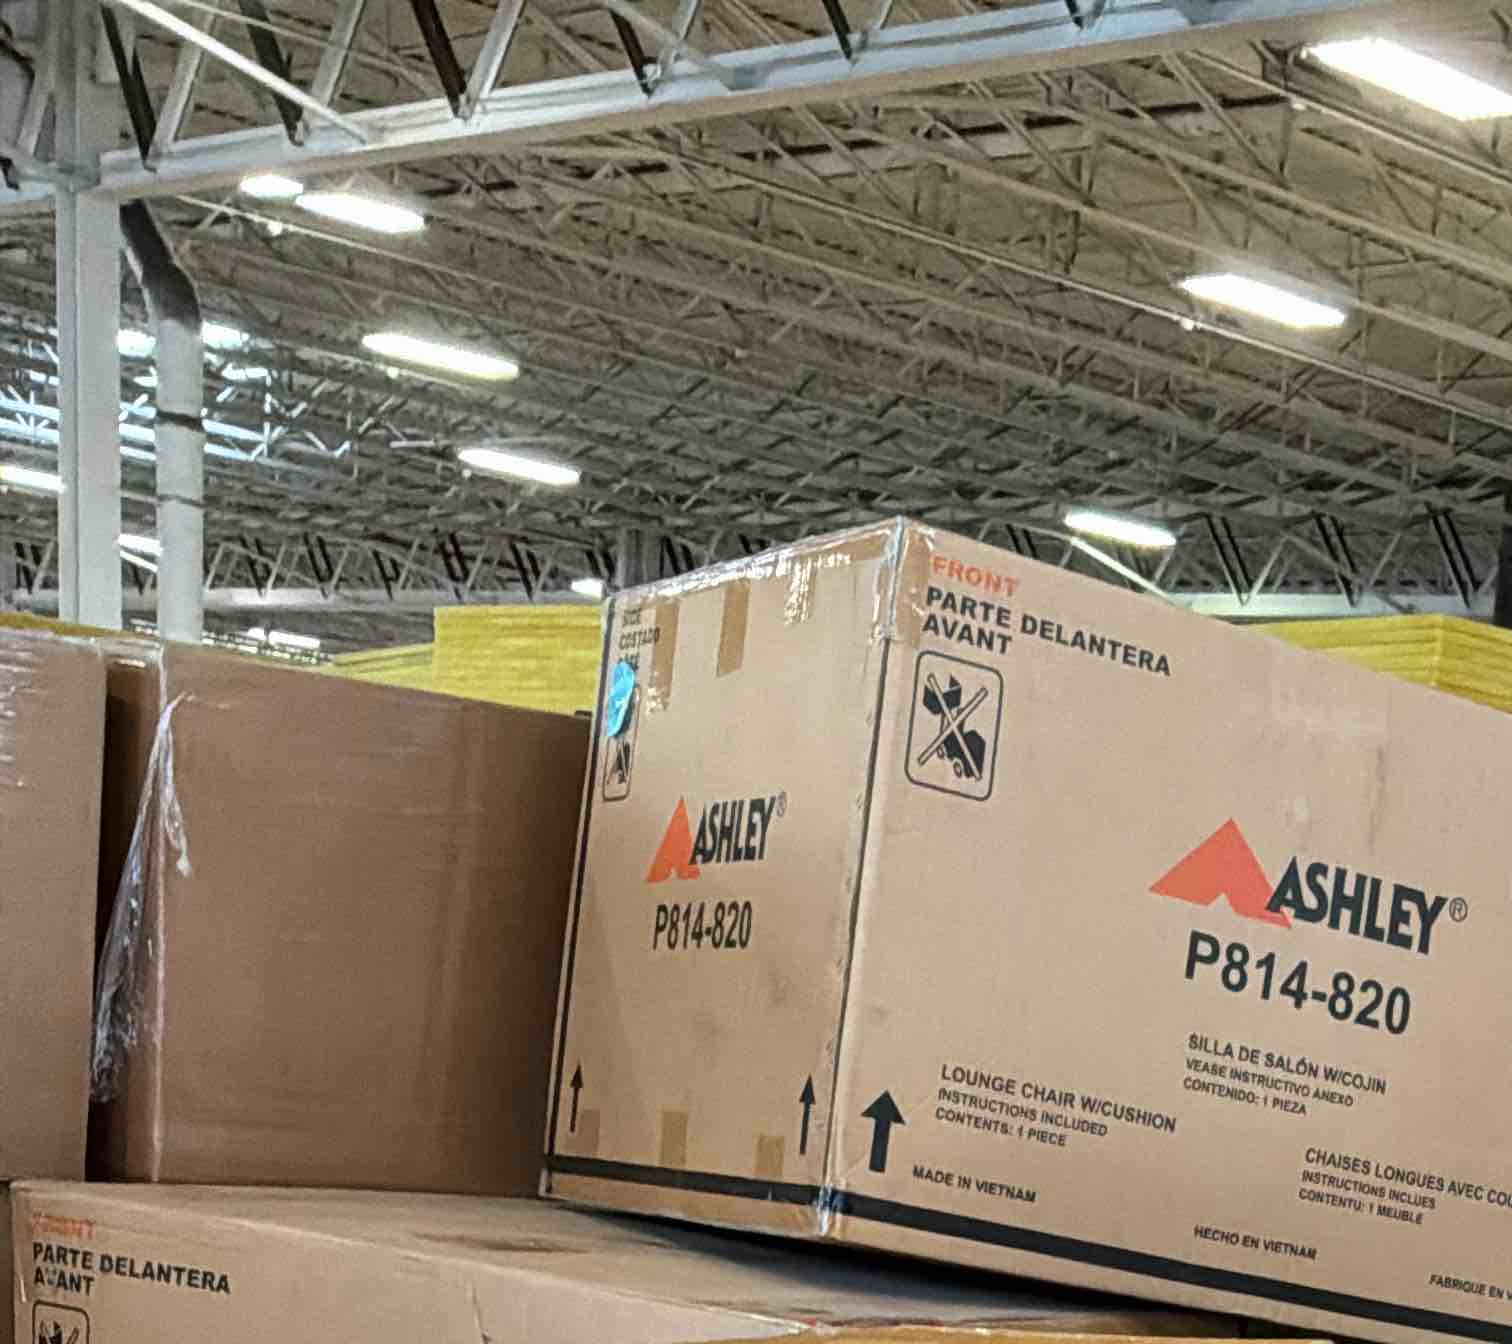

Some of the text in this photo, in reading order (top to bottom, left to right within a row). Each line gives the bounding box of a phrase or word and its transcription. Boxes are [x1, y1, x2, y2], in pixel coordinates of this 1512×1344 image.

[931, 554, 1020, 598] FRONT
[922, 614, 1013, 657] AVANT
[925, 587, 1172, 677] PARTE DELANTERA
[652, 901, 753, 951] P814-820
[1184, 930, 1412, 1036] P814-820
[1186, 1058, 1354, 1109] VEASE INSTRUCTIVO ANEXO
[1188, 1032, 1235, 1062] SILLA
[1238, 1047, 1261, 1067] DE
[1323, 1063, 1388, 1097] W/COJIN
[938, 1087, 1109, 1139] INSTRUCTIONS INCLUDED
[940, 1063, 1178, 1134] LOUNGE CHAIR W/CUSHION
[1271, 1096, 1308, 1117] PIEZA
[935, 1107, 1014, 1139] CONTENTS:
[1025, 1127, 1067, 1148] PIECE
[912, 1165, 1038, 1204] MADE IN VIETNAM
[1301, 1169, 1437, 1211] INSTRUCTIONS INCLUES
[1304, 1147, 1372, 1177] CHAISES
[1374, 1161, 1445, 1192] LONGUES
[1447, 1180, 1485, 1202] AVEC
[32, 1241, 232, 1295] PARTE DELANTERA
[1193, 1226, 1318, 1262] HECHO EN VIETNAM
[1429, 1273, 1486, 1297] FABRIQUE
[1488, 1285, 1505, 1300] EN
